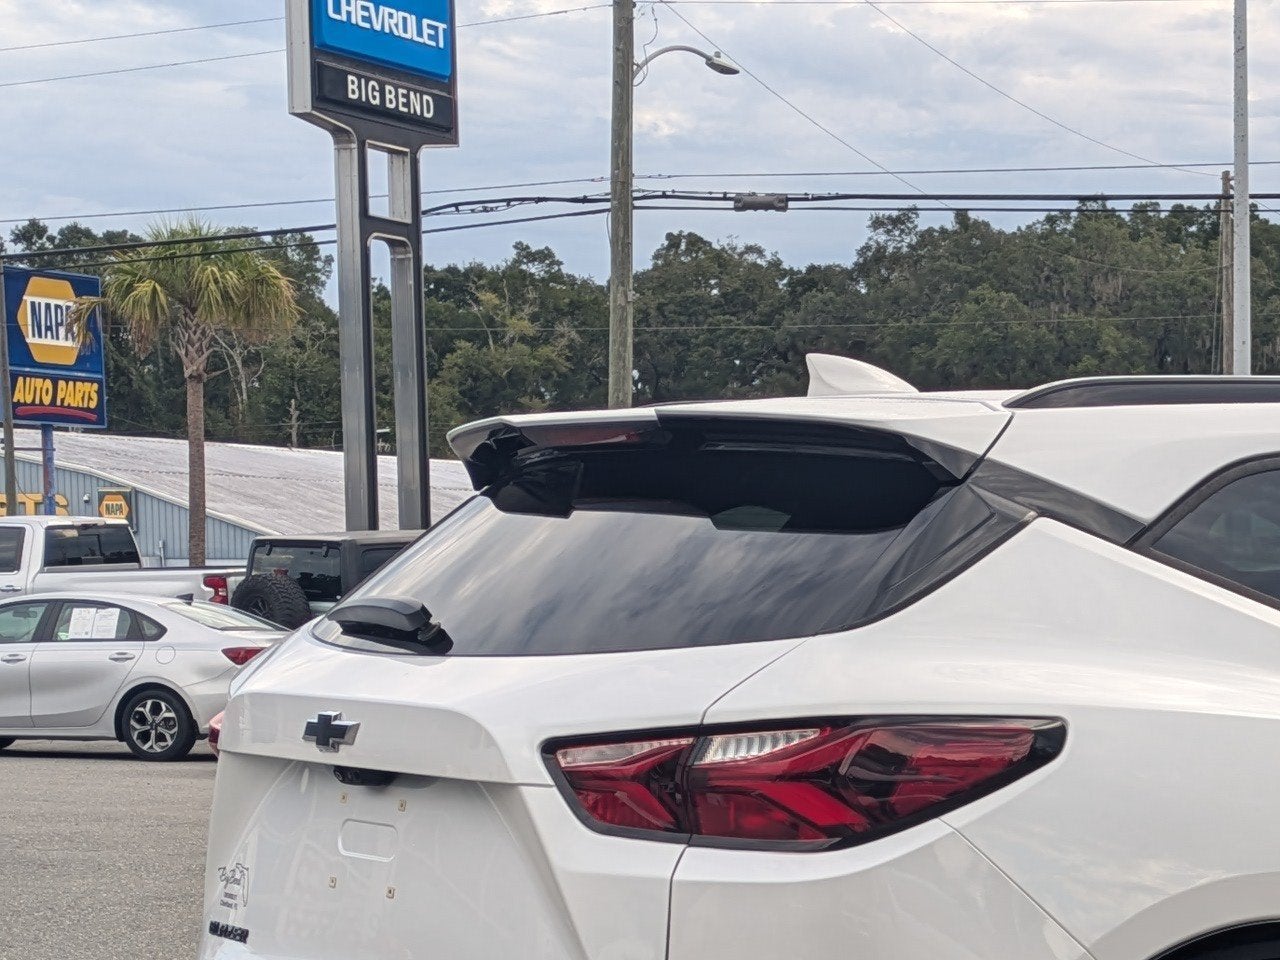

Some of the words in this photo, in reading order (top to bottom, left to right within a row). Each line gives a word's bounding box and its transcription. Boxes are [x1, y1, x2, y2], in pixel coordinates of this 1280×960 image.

[327, 0, 447, 49] CHEVROLET
[347, 74, 380, 106] BIG
[385, 85, 435, 119] BEND
[13, 376, 53, 406] AUTO
[56, 379, 99, 409] PARTS
[104, 502, 124, 516] NAPA
